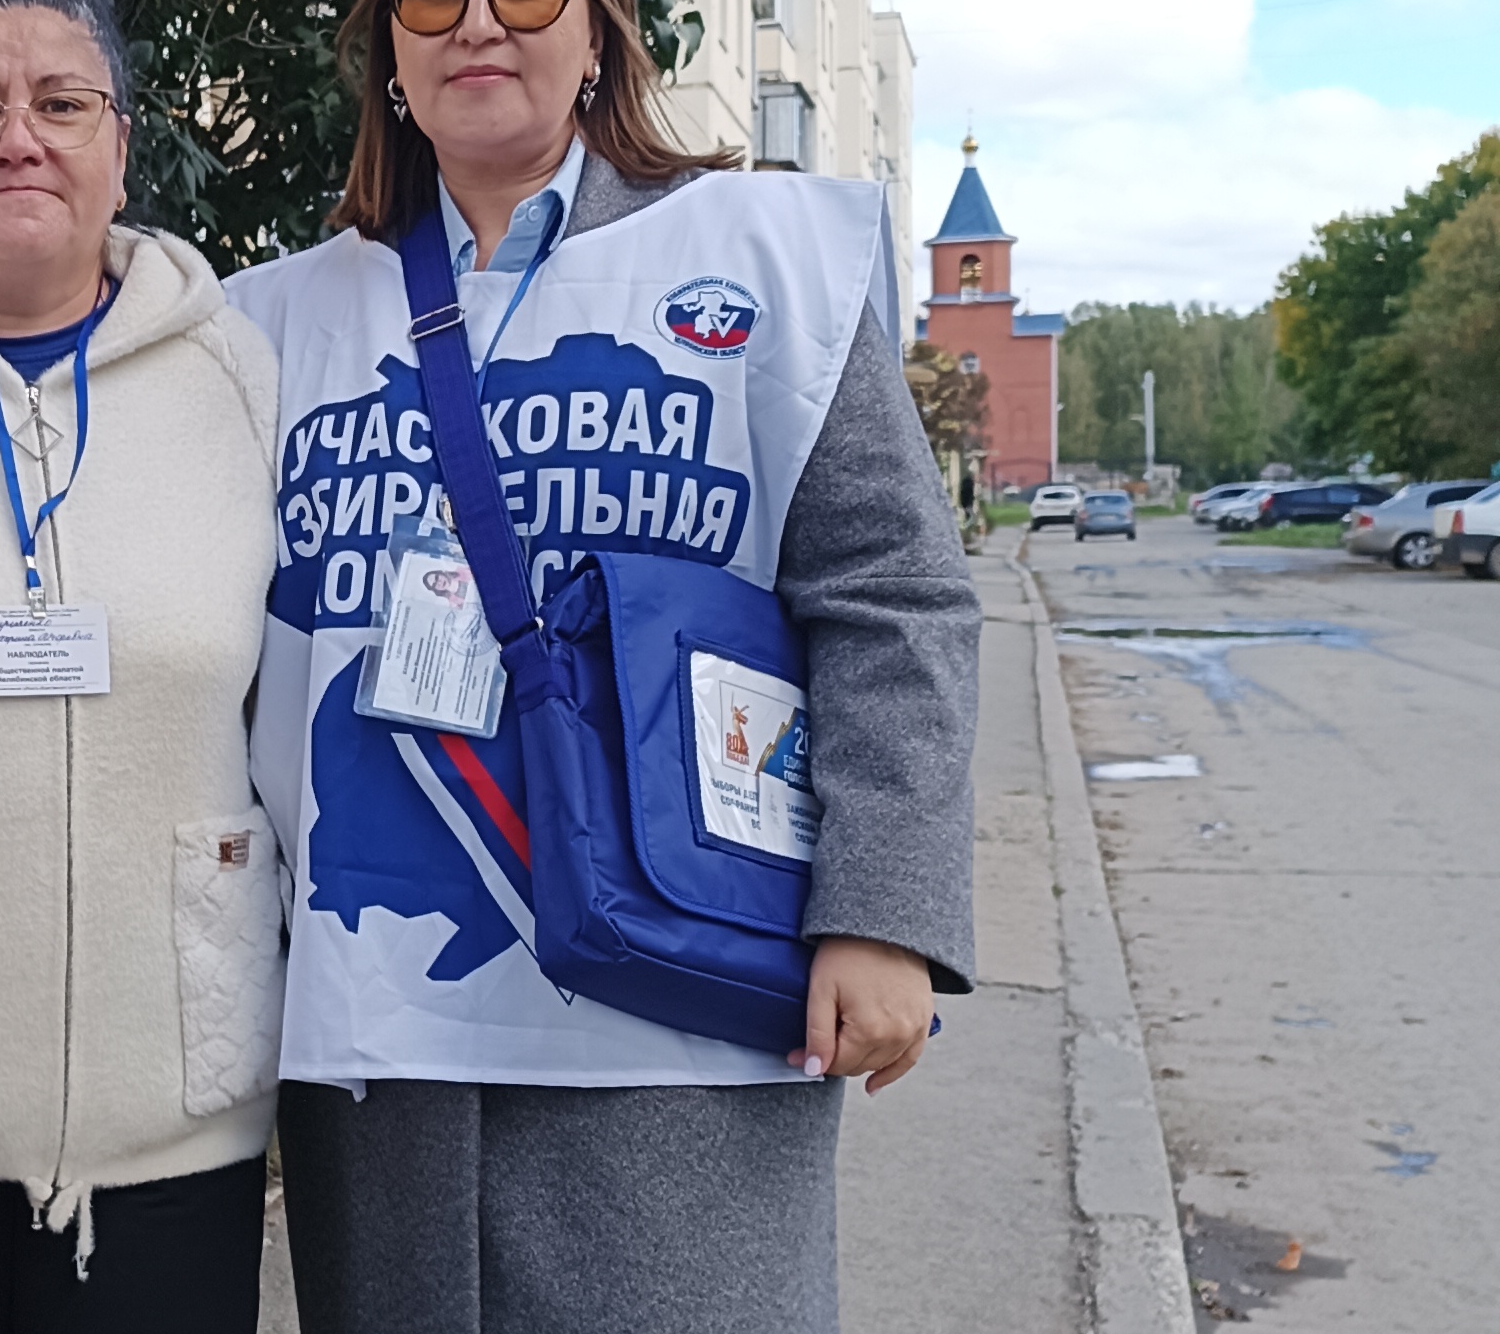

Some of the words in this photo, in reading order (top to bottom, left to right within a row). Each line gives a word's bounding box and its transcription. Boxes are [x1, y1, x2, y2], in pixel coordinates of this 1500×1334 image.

[290, 388, 699, 482] УЧАСКОВАЯ
[278, 468, 737, 568] ЗБИРАЕЛЬНАЯ
[7, 650, 69, 658] НАБЛЮДАТЕЛЬ
